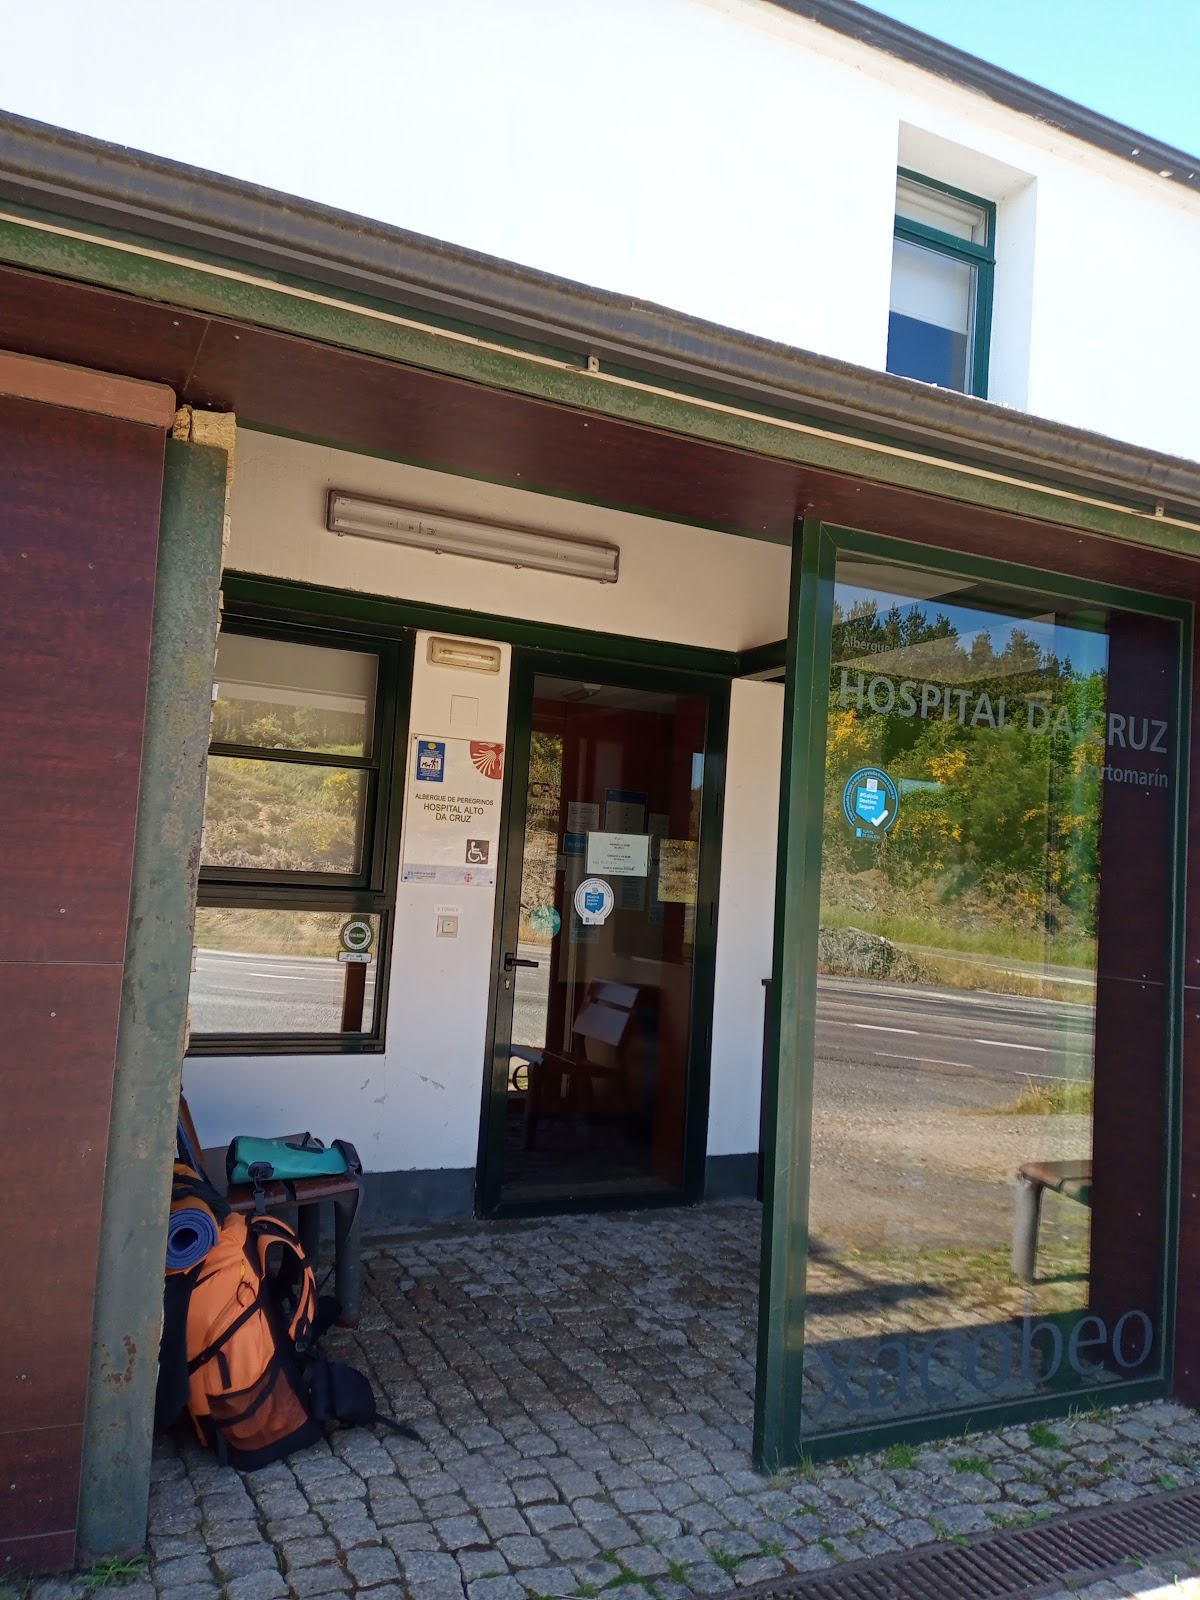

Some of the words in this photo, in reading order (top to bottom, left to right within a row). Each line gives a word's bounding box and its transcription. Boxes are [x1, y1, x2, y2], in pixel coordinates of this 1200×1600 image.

[841, 635, 891, 654] Albergue
[838, 670, 1010, 731] HOSPITAL
[1026, 699, 1076, 742] DA
[1085, 710, 1168, 755] CRUZ
[415, 793, 446, 802] ALBERGUE
[456, 797, 494, 806] PEREGRINOS
[423, 803, 462, 813] HOSPITAL
[463, 806, 484, 815] ALTO
[435, 812, 447, 821] DA
[449, 814, 472, 823] CRUZ
[815, 1294, 1154, 1416] xacobeo
